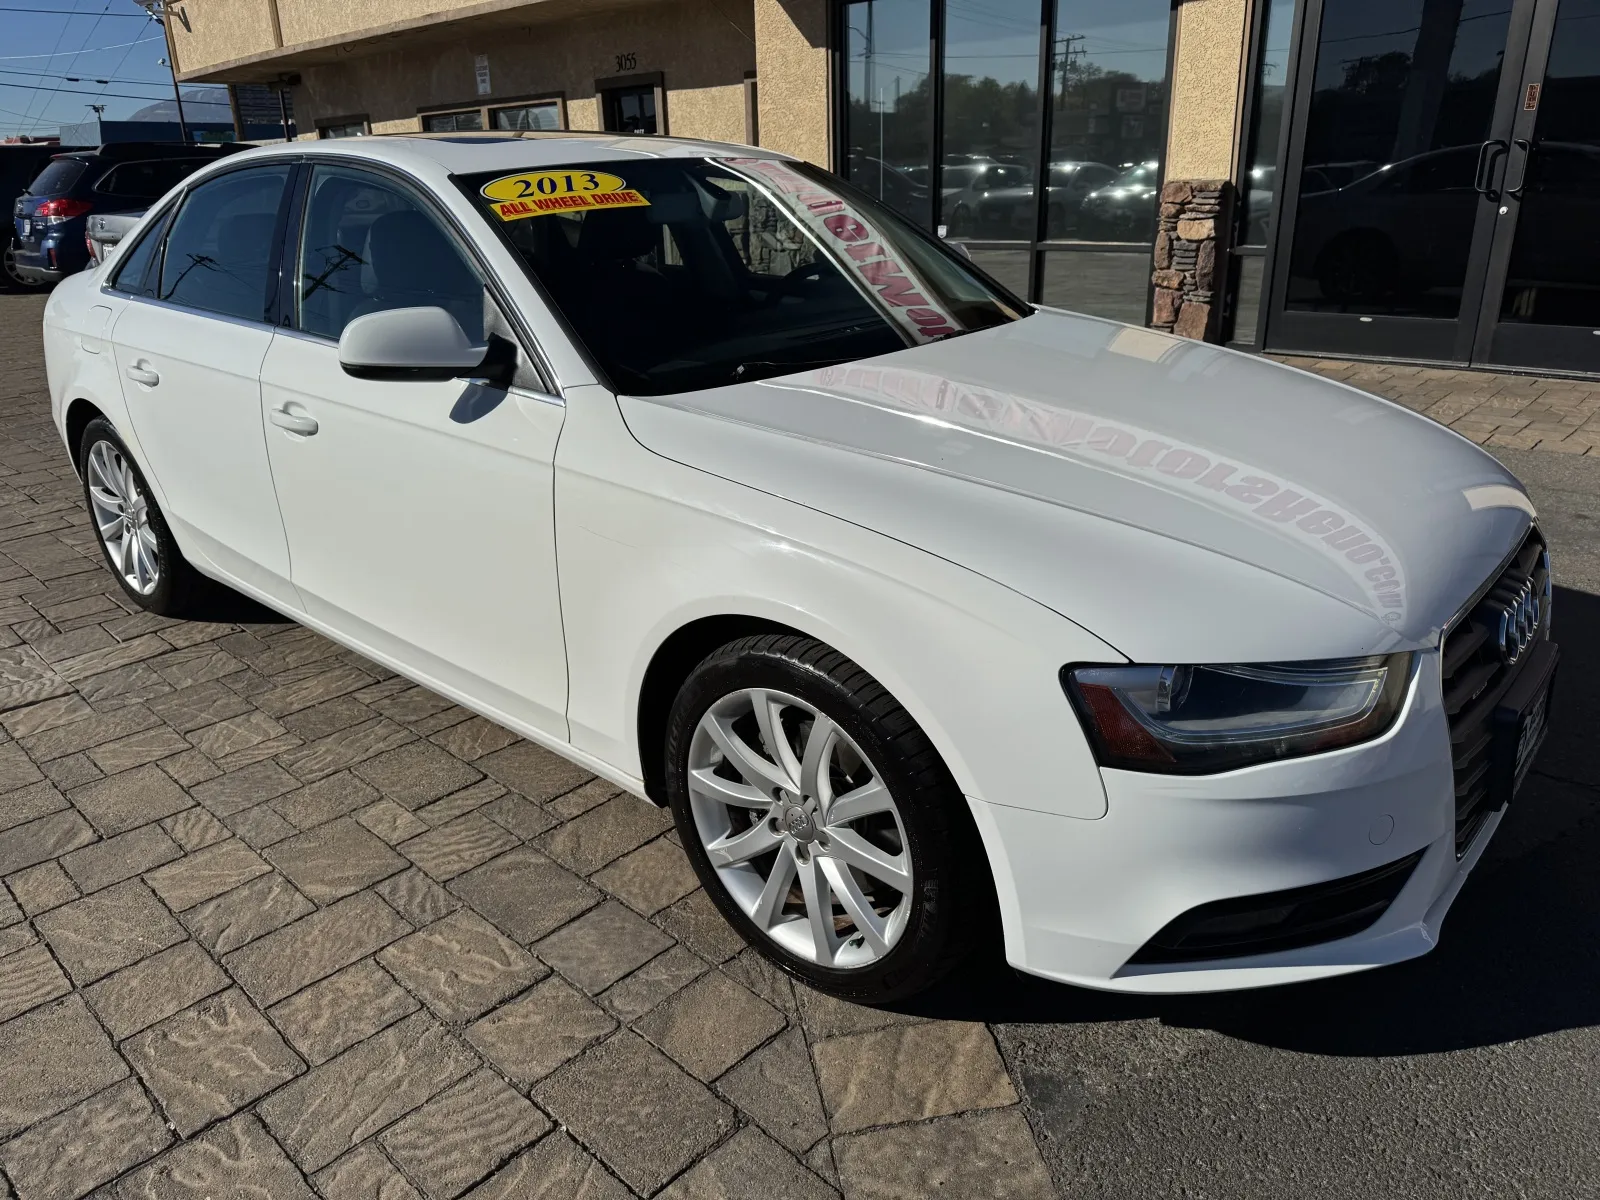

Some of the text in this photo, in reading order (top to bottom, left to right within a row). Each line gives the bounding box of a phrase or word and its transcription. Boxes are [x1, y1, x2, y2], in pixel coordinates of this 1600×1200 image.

[616, 52, 636, 72] 3055
[514, 173, 599, 198] 2013
[500, 191, 639, 217] ALL WHEEL DRIVE
